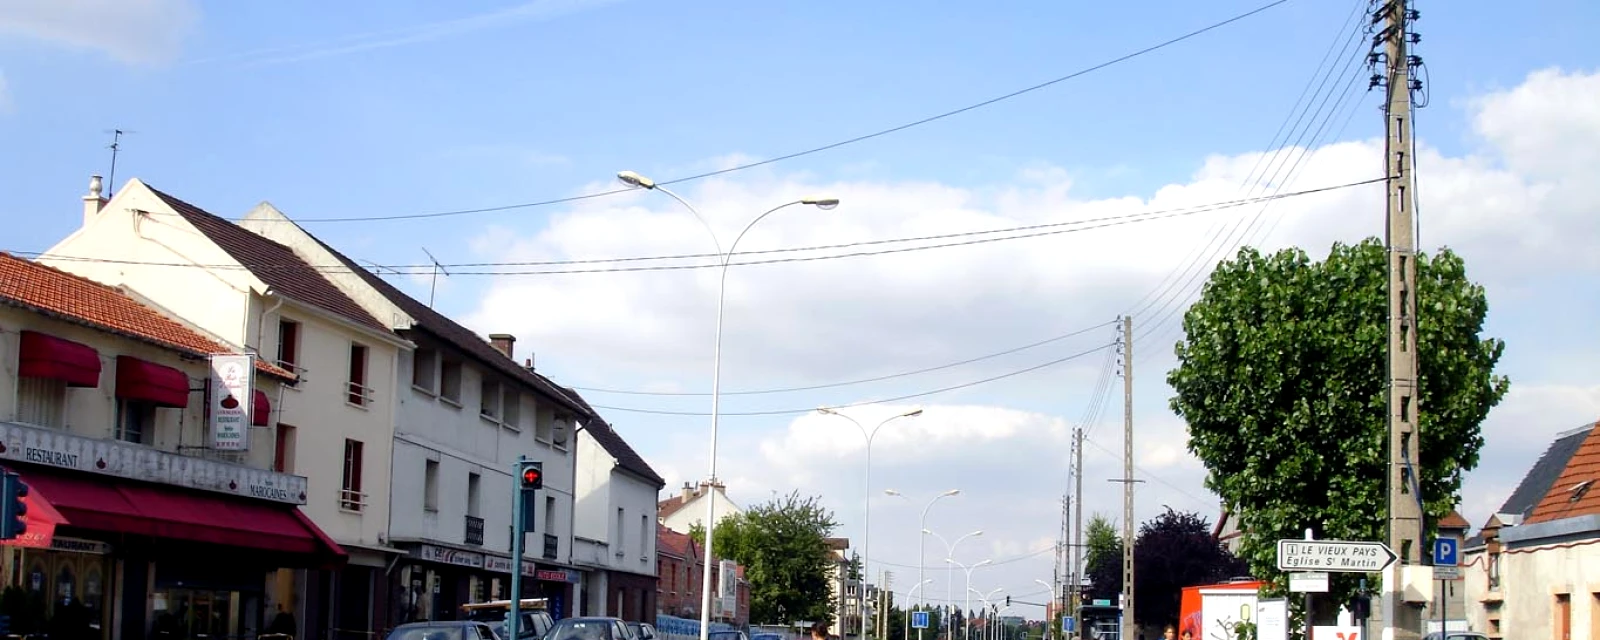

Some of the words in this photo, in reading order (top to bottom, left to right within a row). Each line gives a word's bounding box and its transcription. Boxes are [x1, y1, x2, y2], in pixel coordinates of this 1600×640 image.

[26, 447, 78, 467] RESTAURANT
[250, 484, 287, 500] MAROCAINES
[1301, 545, 1313, 555] LE
[1318, 546, 1348, 555] VIEUX
[1352, 547, 1377, 557] PAYS
[1440, 543, 1451, 561] P
[1286, 556, 1320, 567] Eglise
[1326, 557, 1335, 566] St
[1340, 558, 1377, 567] Martin
